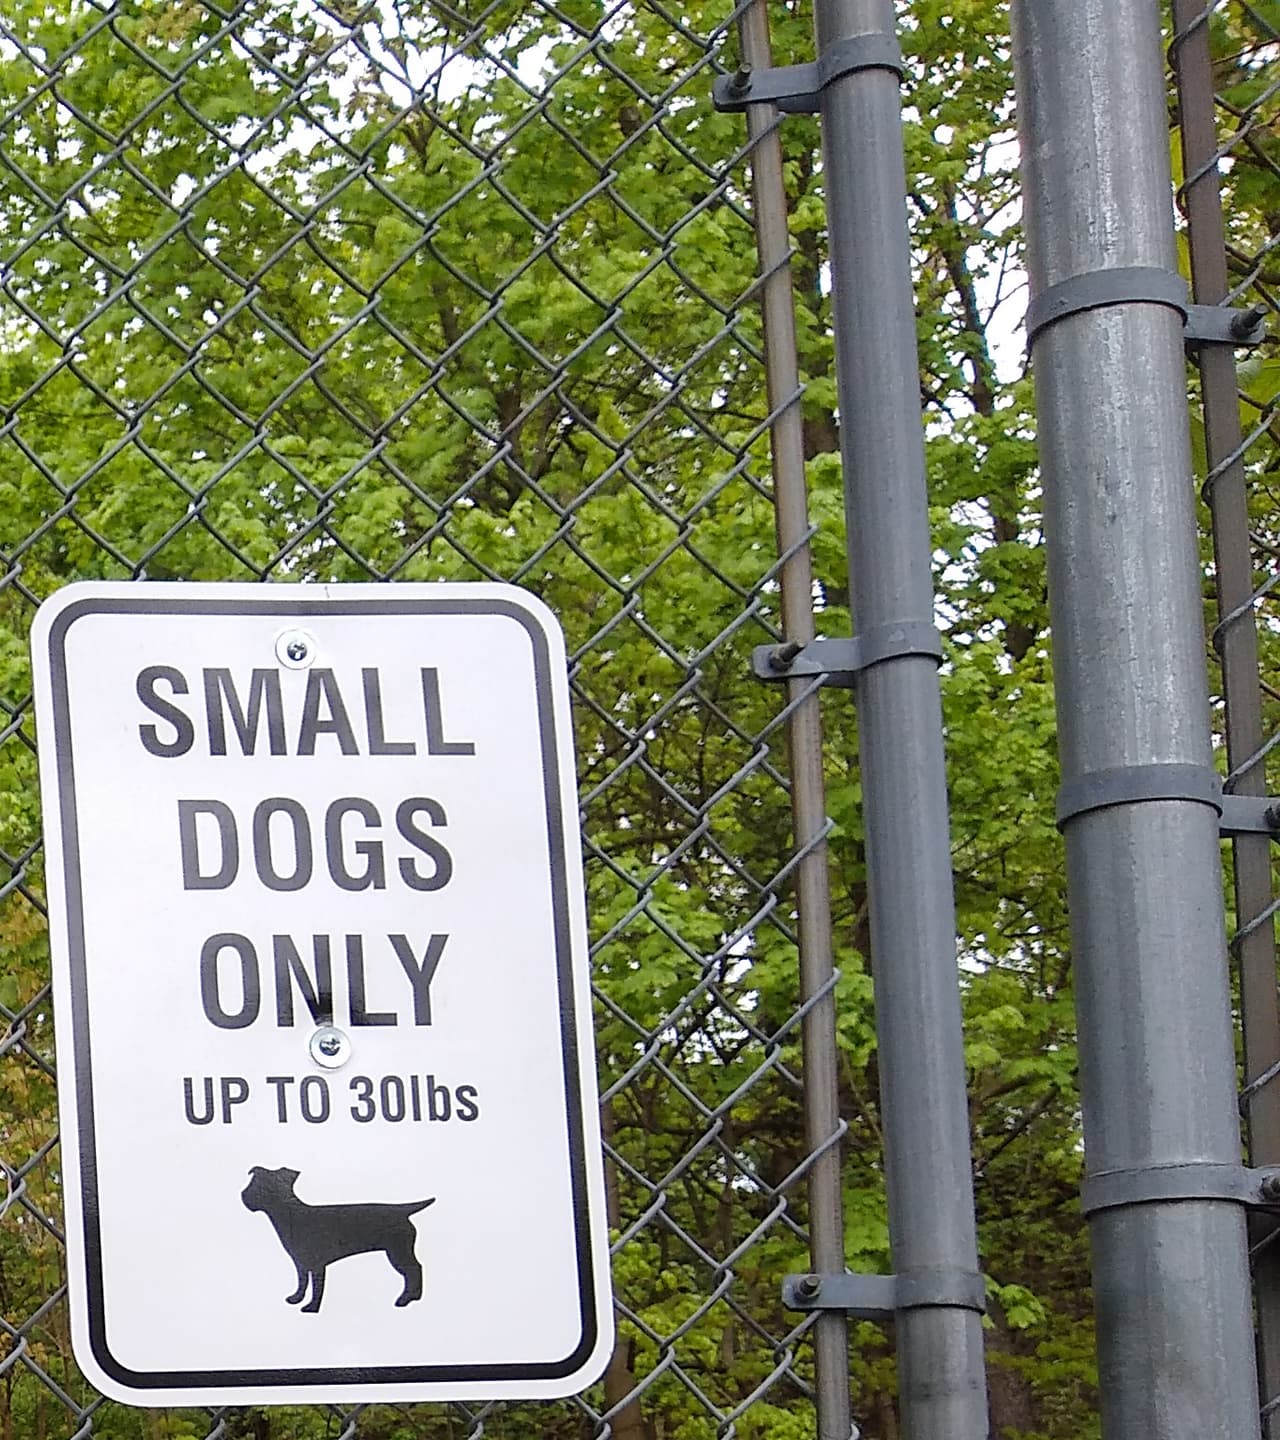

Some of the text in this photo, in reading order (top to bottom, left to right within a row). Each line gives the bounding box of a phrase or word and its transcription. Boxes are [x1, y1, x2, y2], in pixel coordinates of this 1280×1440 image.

[135, 665, 477, 758] SMALL
[177, 797, 454, 892] DOGS
[200, 933, 451, 1030] ONLY
[183, 1074, 480, 1126] UP TO 30lbs
